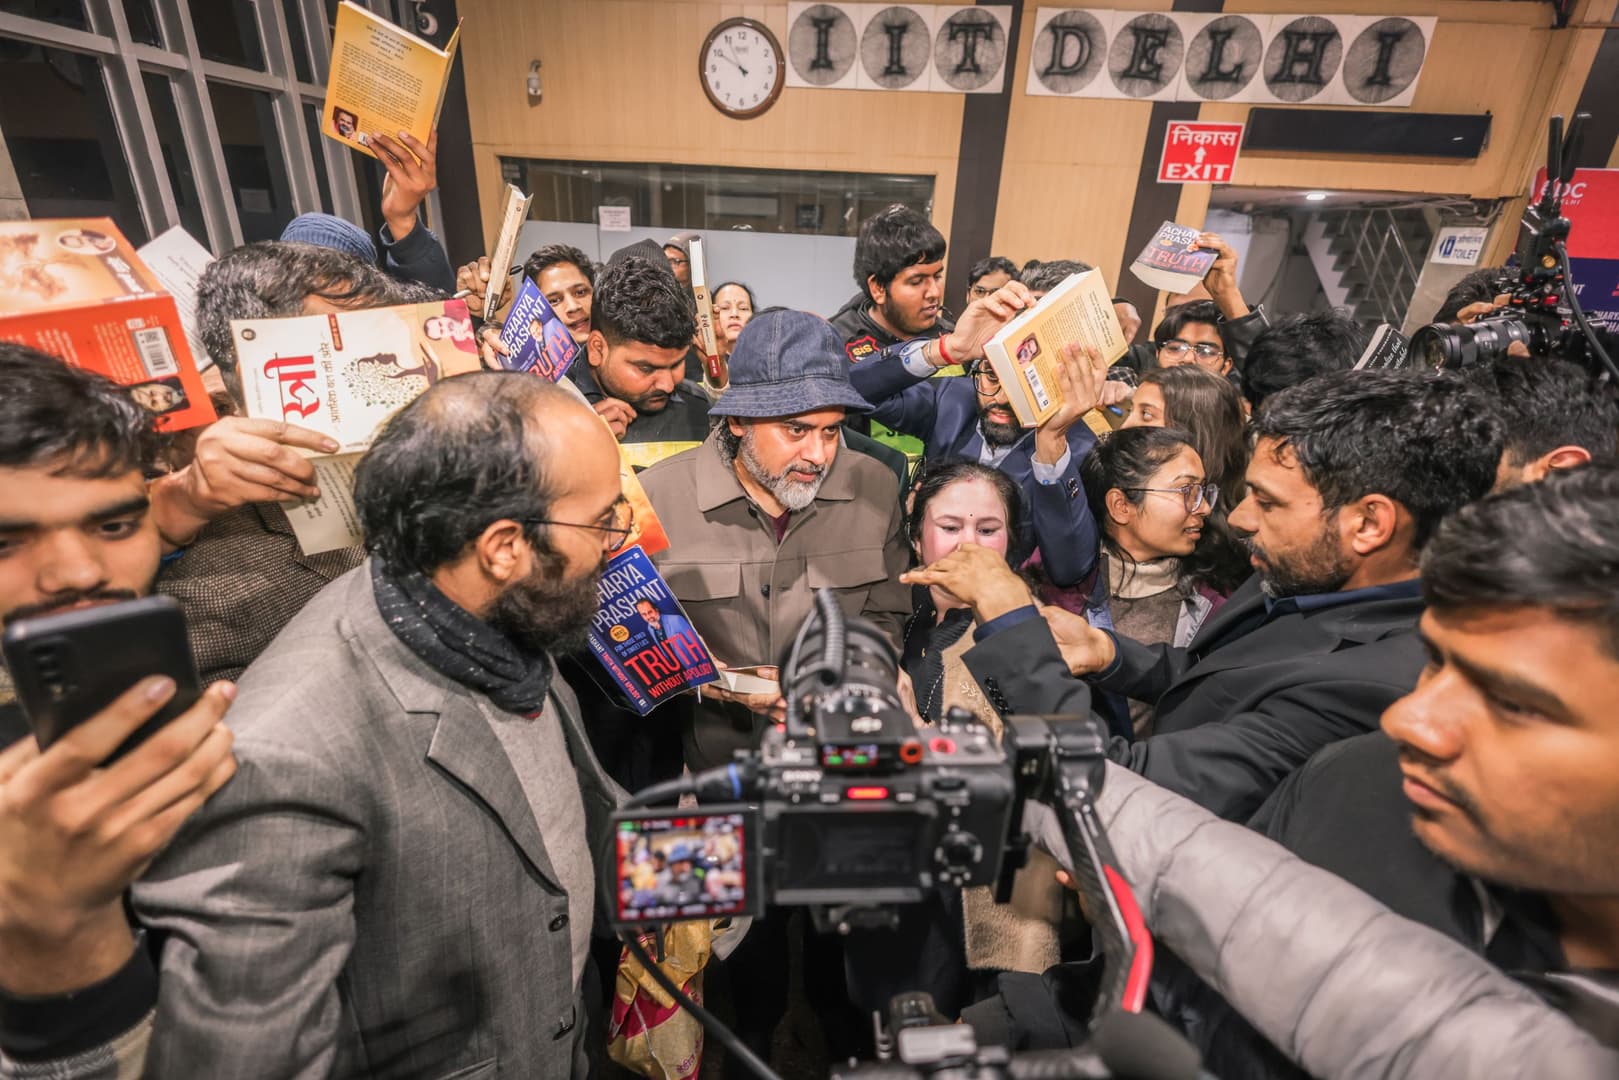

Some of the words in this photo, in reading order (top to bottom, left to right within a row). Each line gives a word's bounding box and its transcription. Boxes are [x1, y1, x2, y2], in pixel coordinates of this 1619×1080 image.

[738, 31, 747, 40] 12
[713, 49, 723, 57] 10
[1044, 24, 1405, 86] DELHI
[1171, 125, 1238, 146] निकास
[1165, 163, 1231, 180] EXIT
[1150, 246, 1208, 270] TRUTH
[1454, 248, 1479, 259] TOILET
[263, 352, 320, 423] स्त्री
[597, 563, 646, 604] HARYA
[623, 629, 707, 686] TRUTH
[648, 672, 685, 698] WITHOUT
[682, 662, 713, 681] APOLOGY
